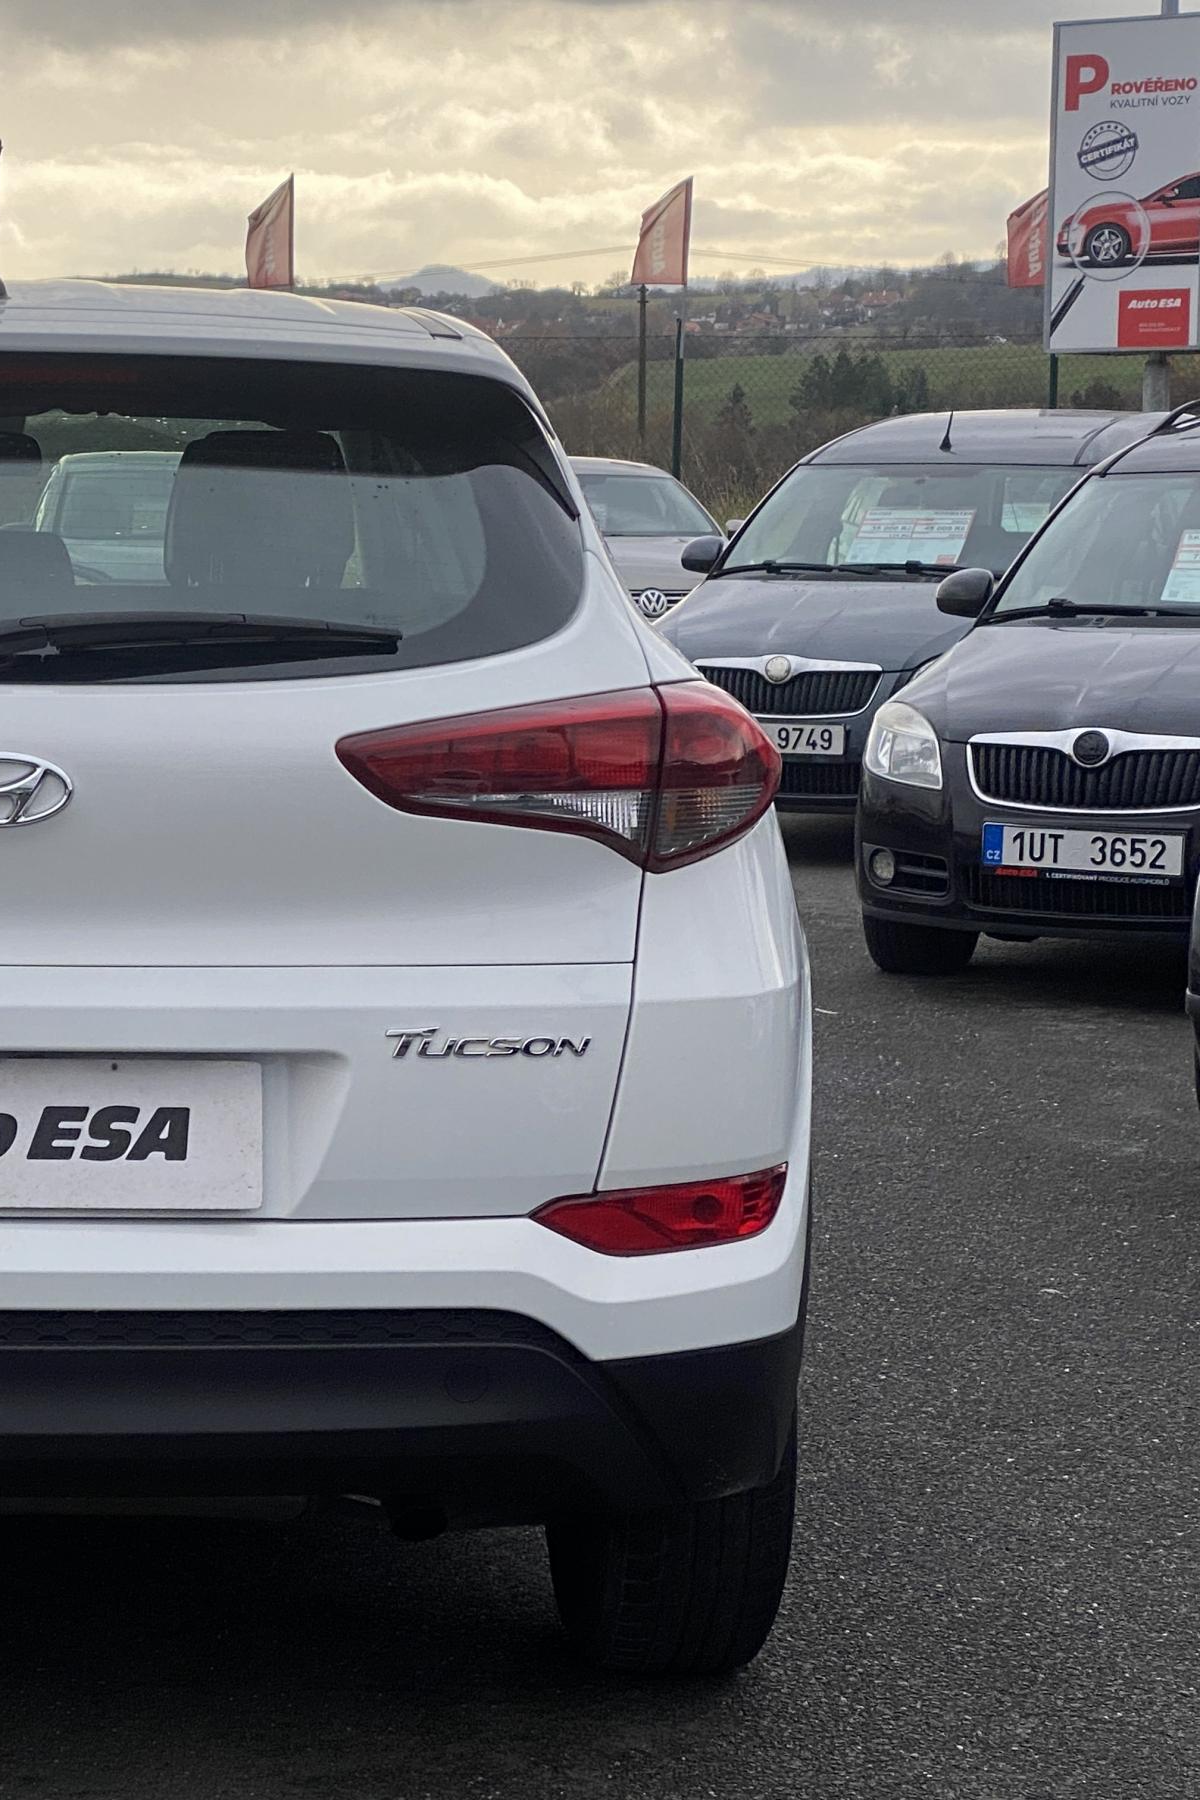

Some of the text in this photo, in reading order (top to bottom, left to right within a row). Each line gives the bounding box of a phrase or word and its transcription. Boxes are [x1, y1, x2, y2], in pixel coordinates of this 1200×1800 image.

[1110, 95, 1191, 109] KVALITNÍ VOZY
[1081, 137, 1136, 163] CERTIFIKÁT
[1127, 298, 1182, 310] Auto ESA
[777, 727, 832, 750] 9749
[986, 831, 1166, 870] CZ 1UT 3652
[385, 1026, 593, 1059] TUCSON
[26, 1105, 191, 1161] ESA
